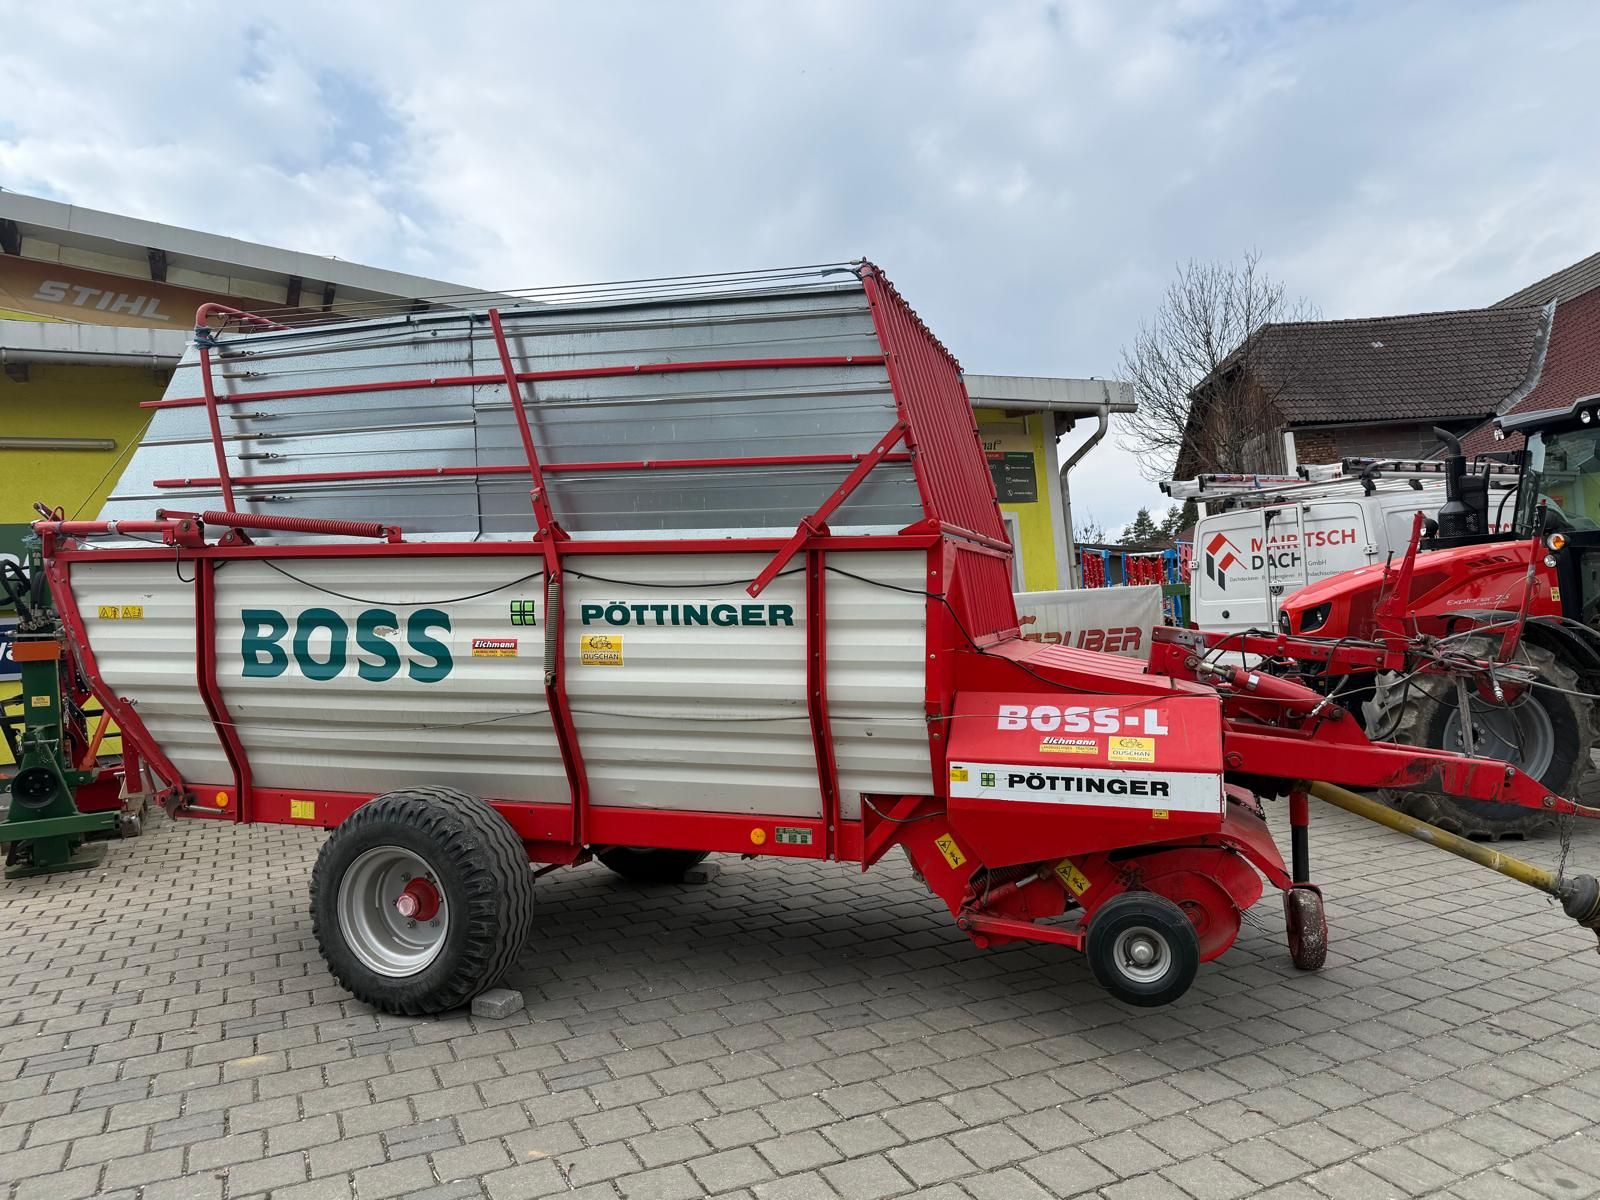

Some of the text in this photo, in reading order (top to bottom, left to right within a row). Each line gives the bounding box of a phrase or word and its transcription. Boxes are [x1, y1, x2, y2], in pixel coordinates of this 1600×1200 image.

[32, 280, 171, 321] STIHL
[581, 601, 794, 626] PÖTTINGER
[241, 607, 454, 683] BOSS
[474, 640, 516, 649] Eichmann
[997, 705, 1168, 735] BOSS-L
[1042, 736, 1096, 746] Eichmann
[1008, 772, 1169, 797] PÖTTINGER
